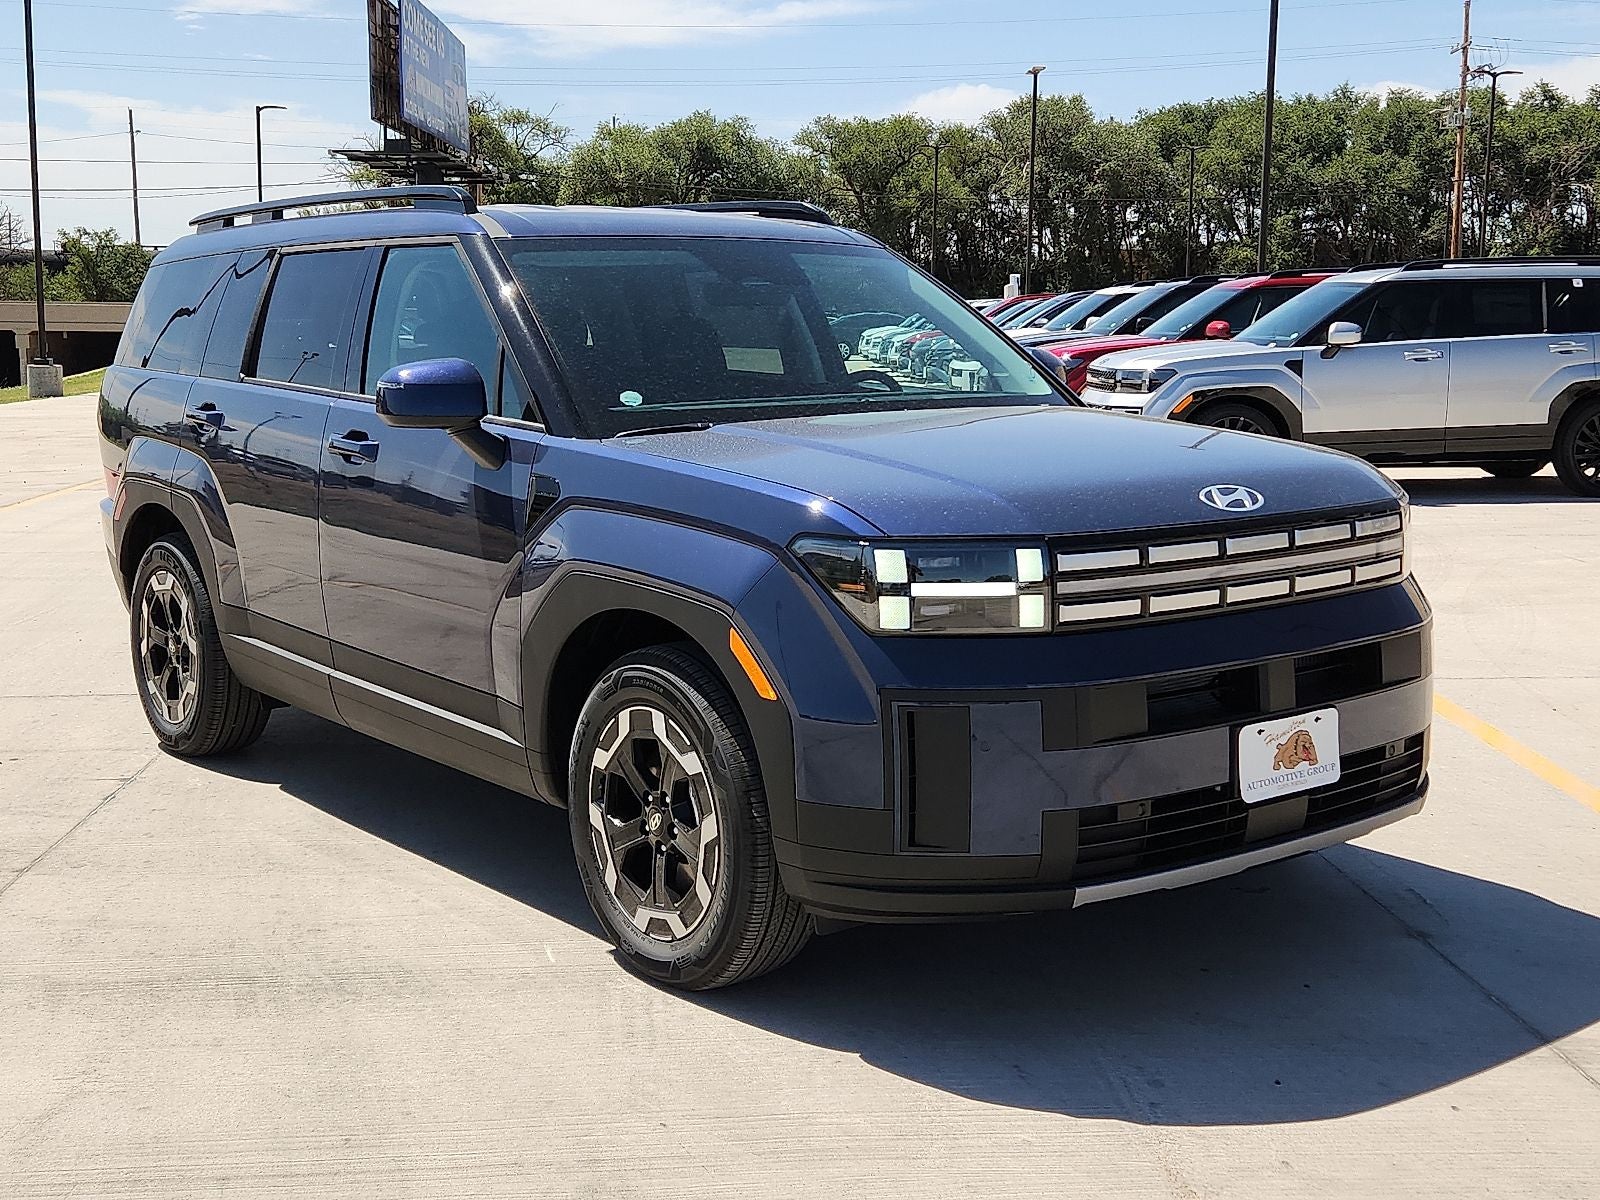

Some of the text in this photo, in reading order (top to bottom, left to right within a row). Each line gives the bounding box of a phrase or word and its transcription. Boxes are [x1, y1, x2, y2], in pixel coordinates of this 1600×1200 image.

[403, 1, 445, 59] COME SEE US
[1246, 770, 1306, 791] AUTOMOTIVE
[1307, 763, 1336, 777] GROUP
